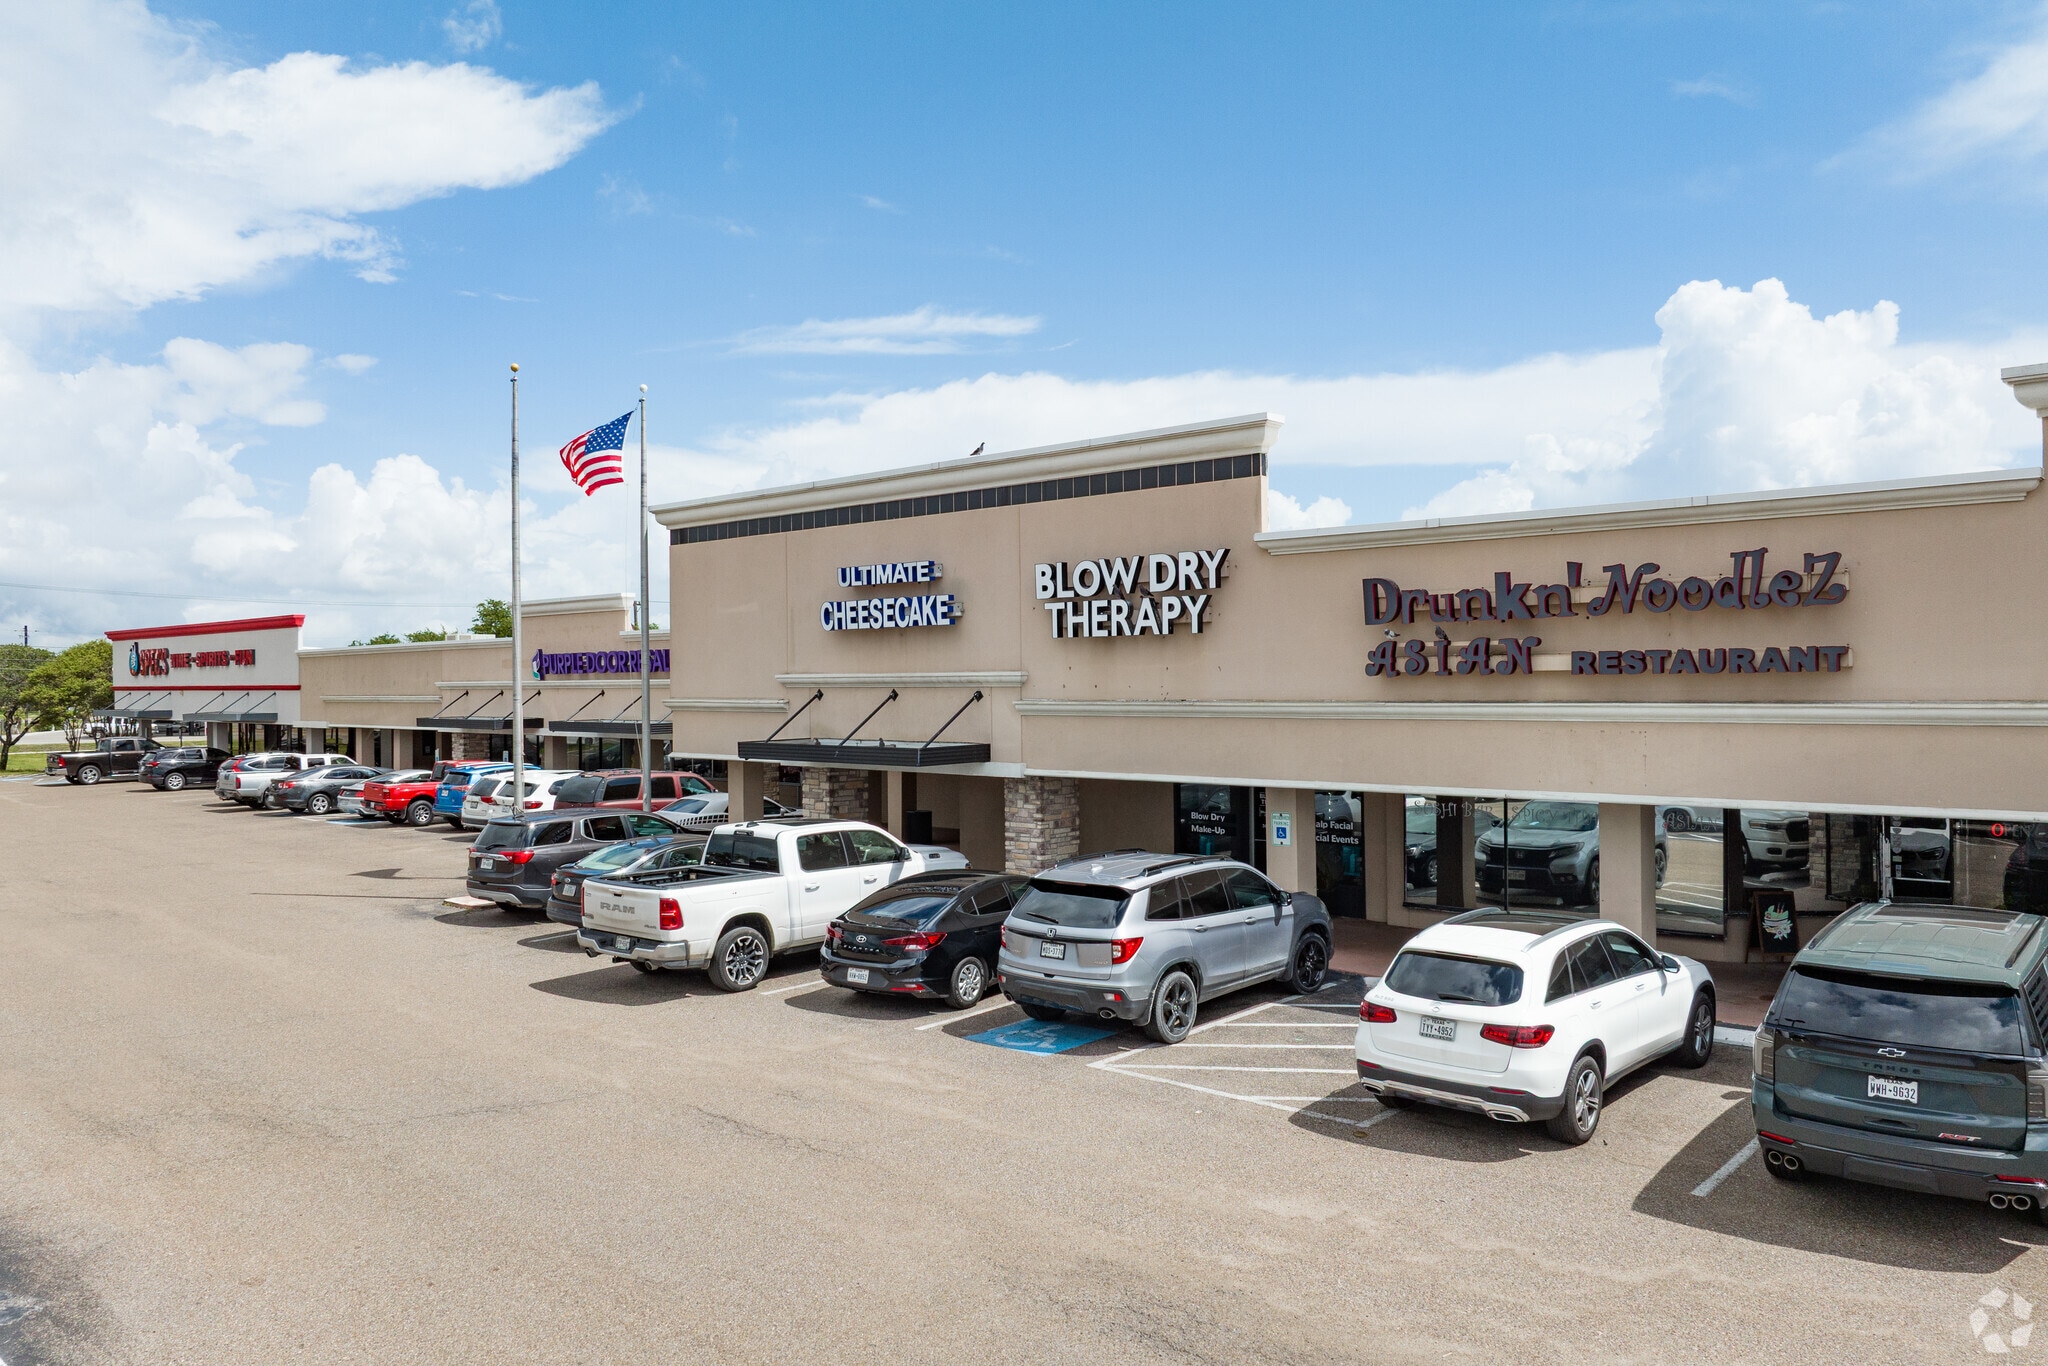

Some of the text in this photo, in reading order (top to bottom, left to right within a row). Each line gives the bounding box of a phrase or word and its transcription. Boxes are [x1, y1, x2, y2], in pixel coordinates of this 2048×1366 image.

[837, 561, 933, 588] ULTIMATE
[1035, 548, 1230, 600] BLOW DRY
[820, 595, 953, 632] CHEESECAKE
[1044, 595, 1211, 639] THERAPY
[196, 650, 230, 667] SPIRITS
[543, 652, 585, 674] PURPLE
[586, 651, 629, 674] DOOR
[1364, 637, 1849, 677] ASIAN RESTAURANT
[1191, 811, 1225, 825] Blow Dry
[1330, 821, 1354, 830] Facial
[1191, 825, 1226, 836] Make-Up
[1331, 835, 1359, 845] Events
[600, 902, 636, 915] RAM
[1861, 1061, 1921, 1074] TAHOE
